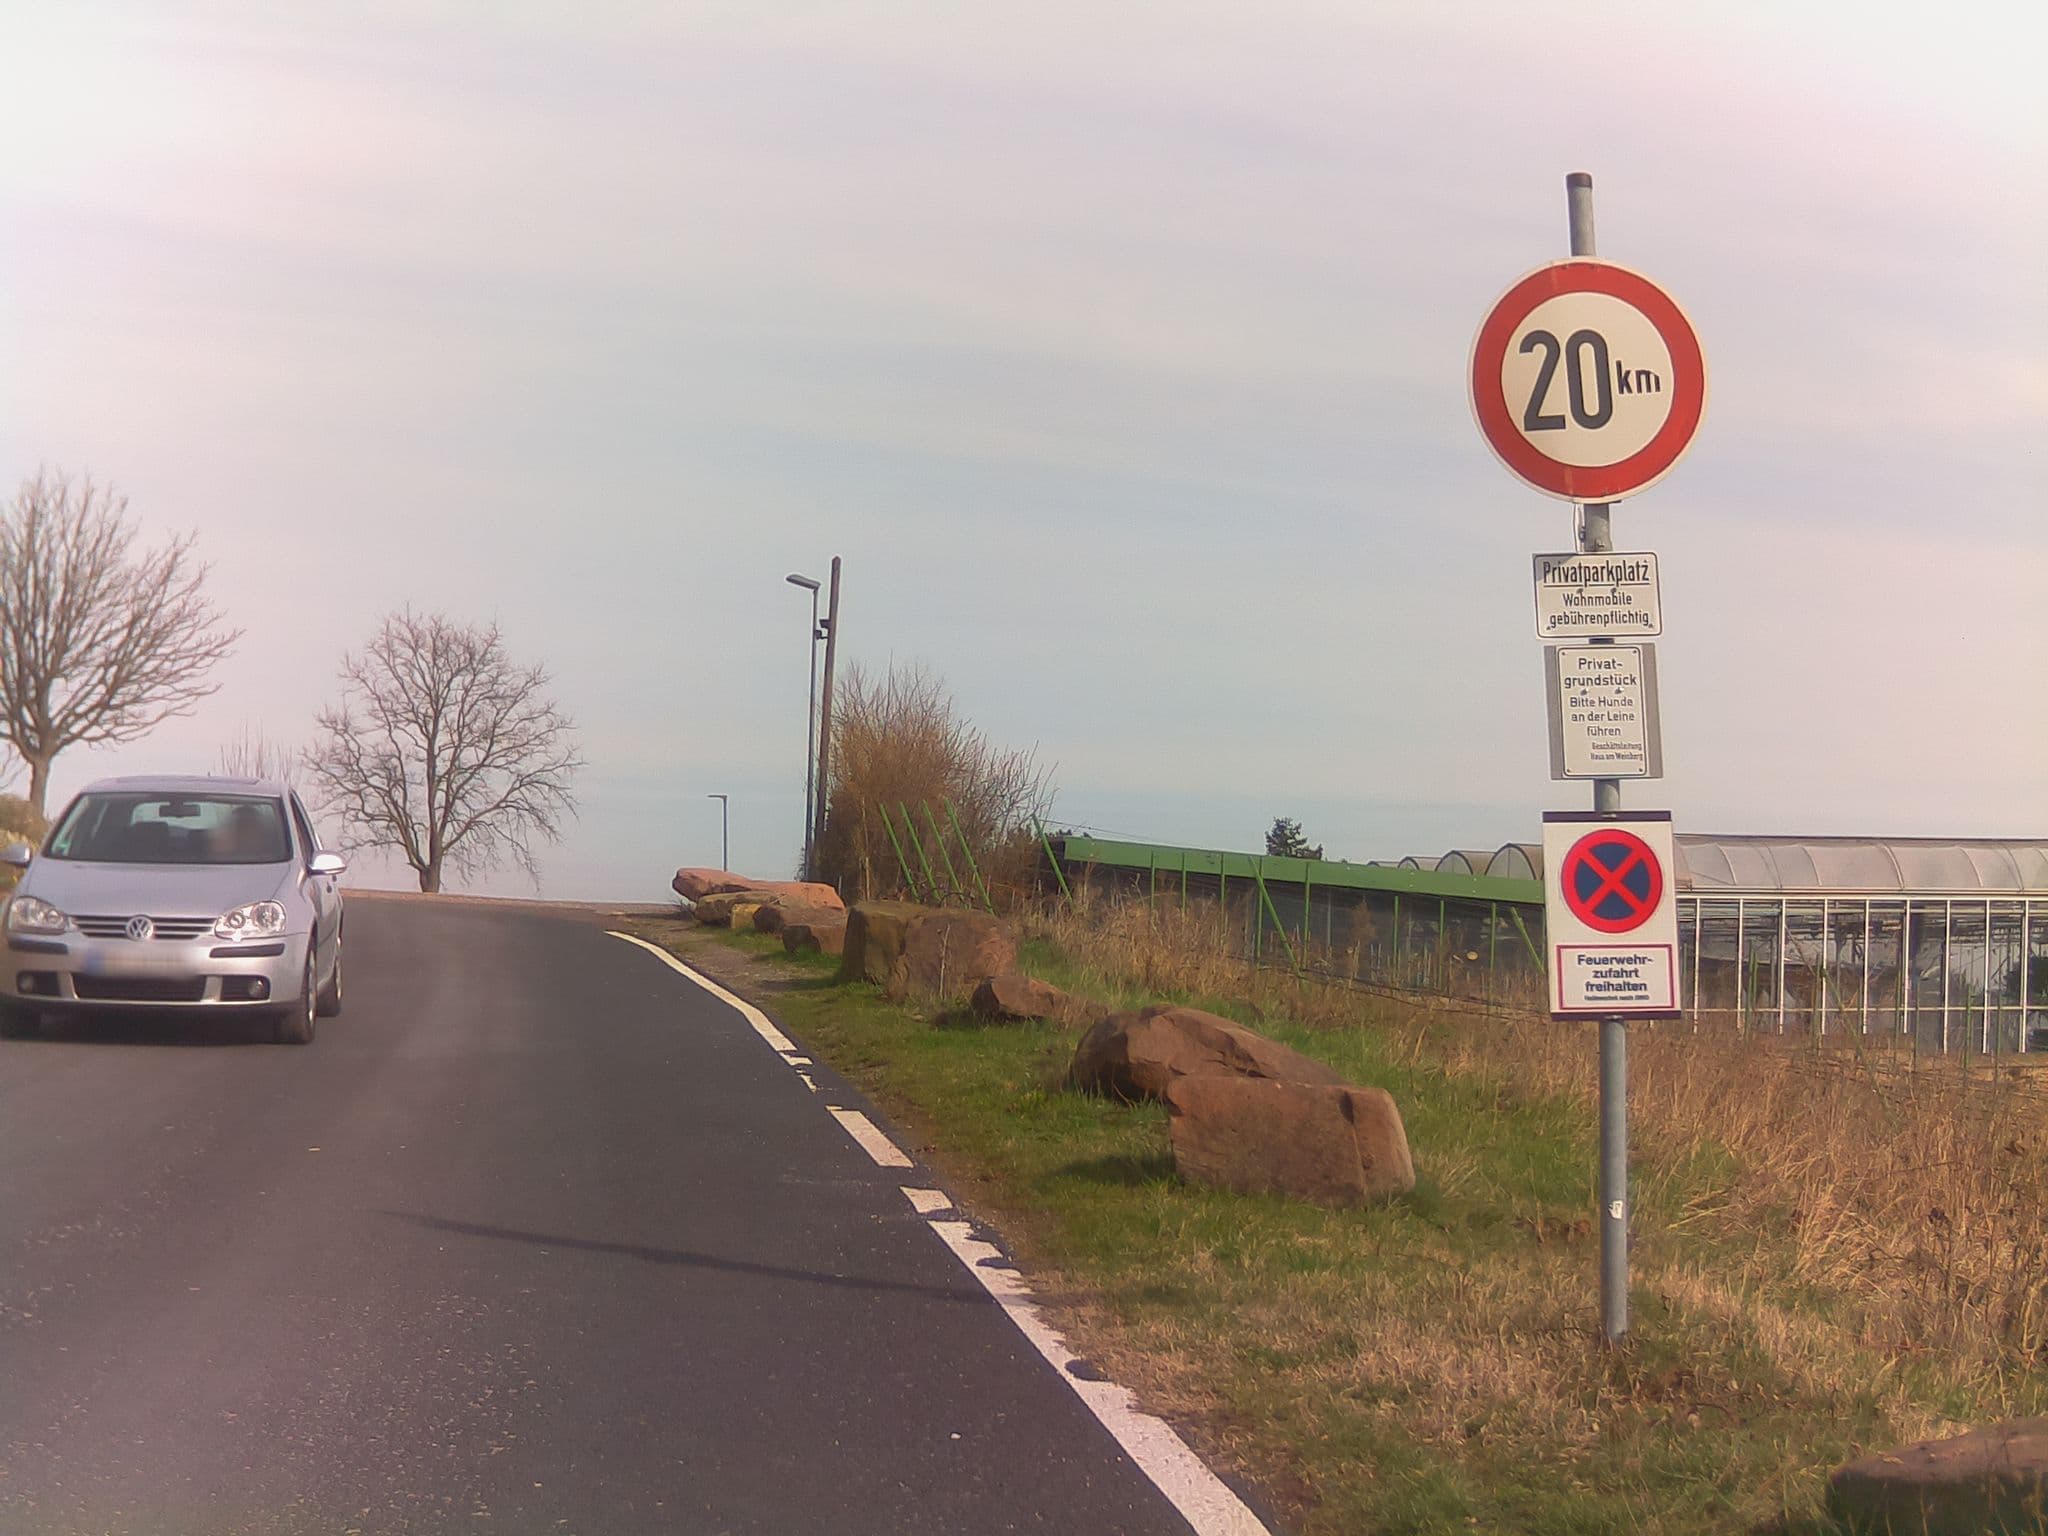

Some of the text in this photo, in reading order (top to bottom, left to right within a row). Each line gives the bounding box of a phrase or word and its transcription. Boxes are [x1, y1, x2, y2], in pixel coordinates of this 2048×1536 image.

[1519, 329, 1661, 432] 20 km
[1543, 560, 1649, 587] Privatparkplatz
[1563, 591, 1632, 606] Wohnmobile
[1550, 610, 1649, 628] gebührenpflichtig
[1578, 658, 1623, 670] Privat-
[1564, 674, 1637, 689] grundstück
[1570, 696, 1633, 707] Bitte Hunde
[1571, 711, 1635, 722] an der Leine
[1587, 726, 1621, 736] führen
[1577, 954, 1653, 965] Feuerwehr-
[1592, 967, 1640, 979] zufahrt
[1585, 981, 1647, 992] freihalten
